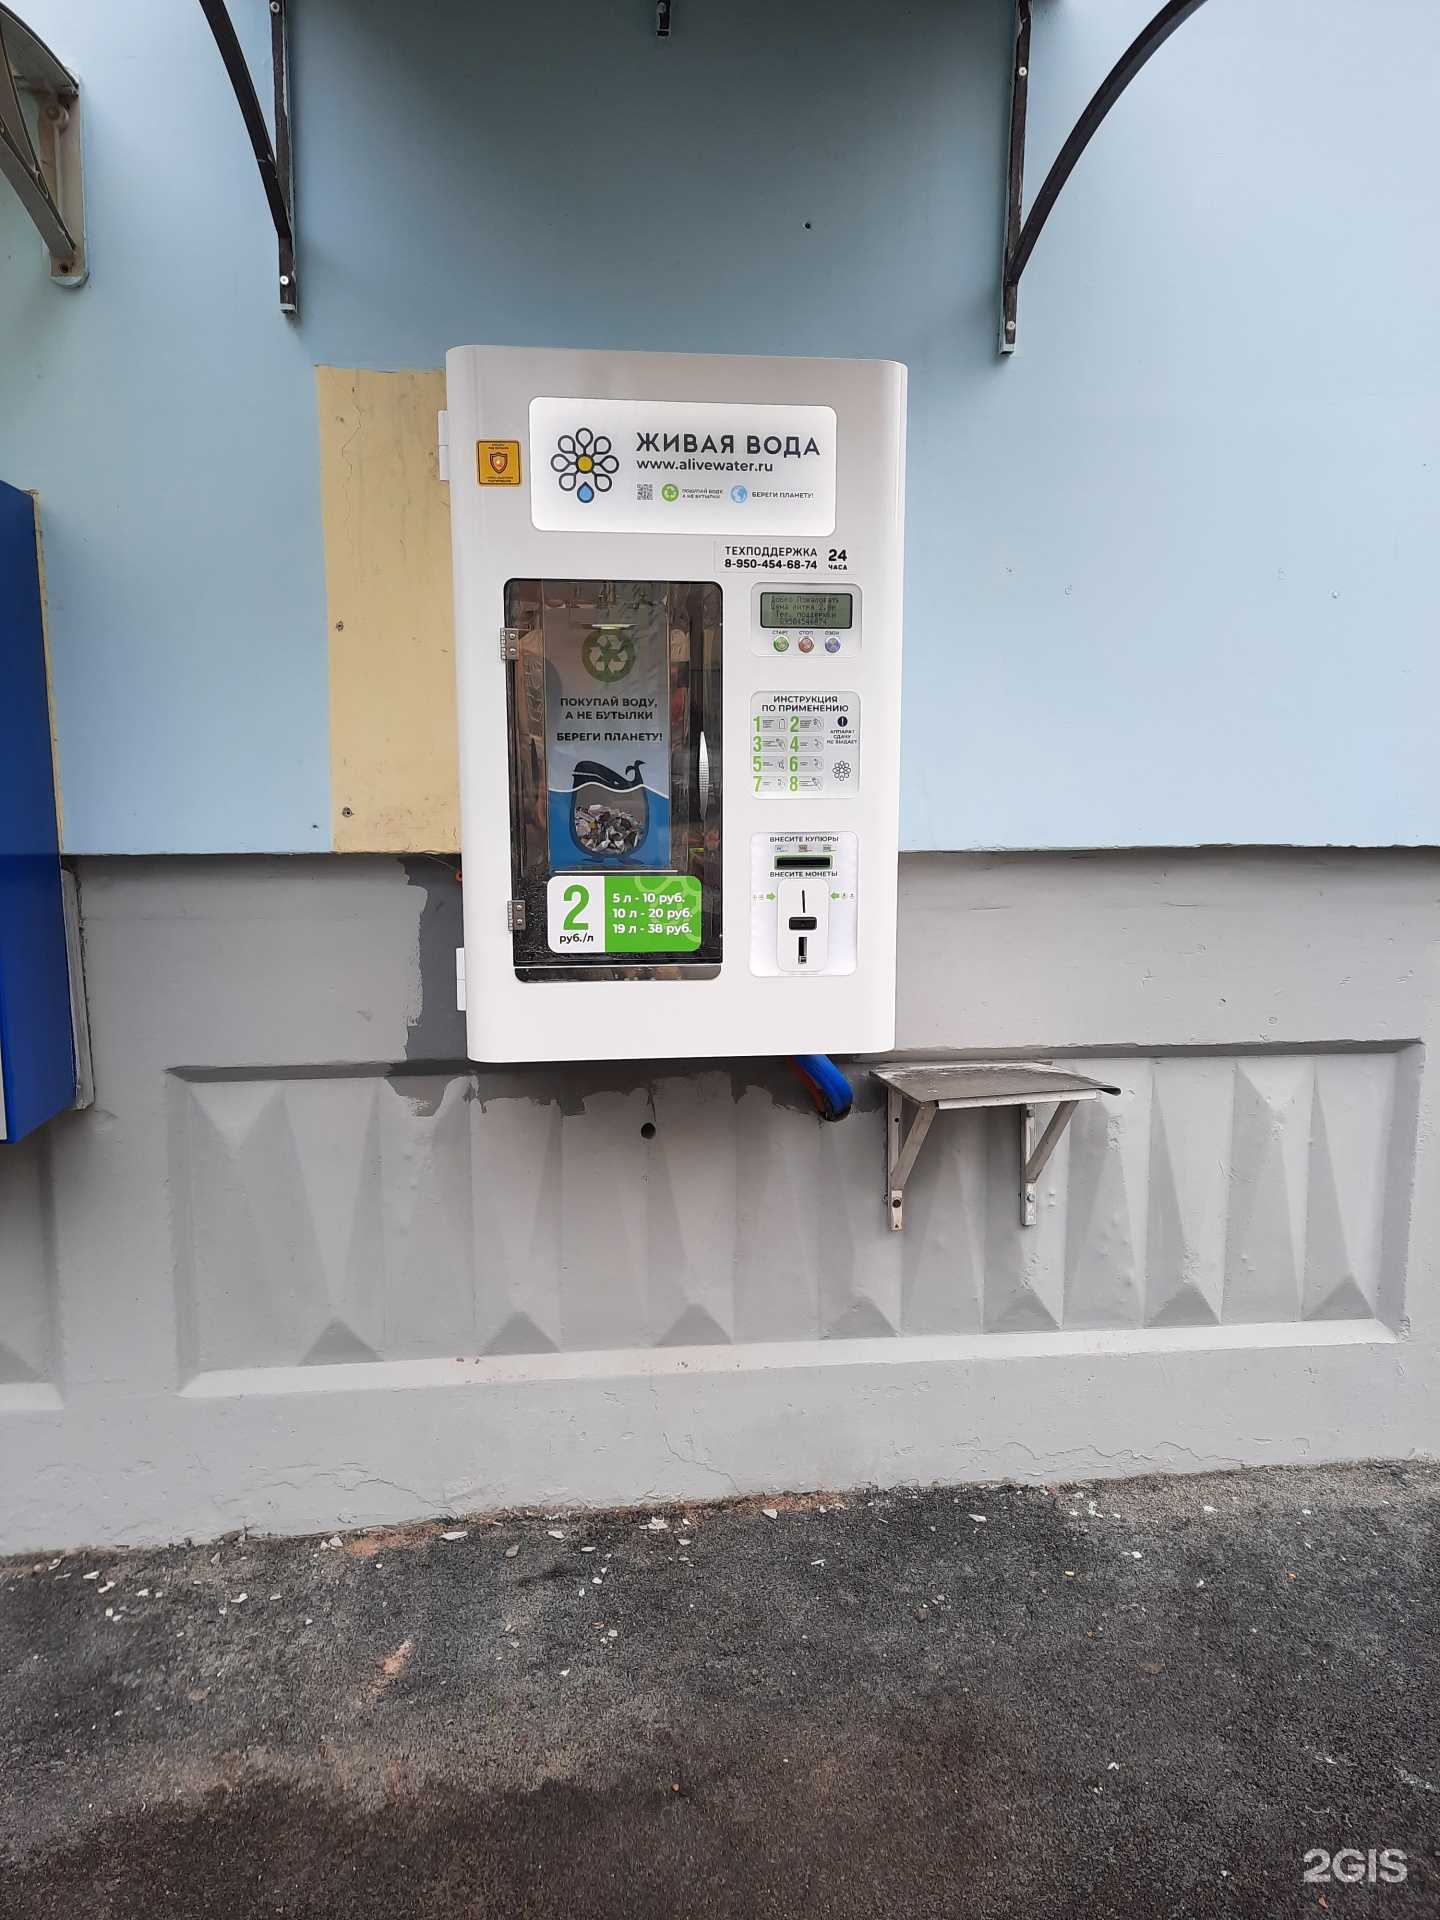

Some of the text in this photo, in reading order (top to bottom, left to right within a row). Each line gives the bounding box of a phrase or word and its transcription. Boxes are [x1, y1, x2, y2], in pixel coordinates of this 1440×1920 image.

[636, 432, 821, 458] ЖИВАЯ ВОДА
[636, 458, 773, 472] www.alivewater.ru
[725, 546, 818, 557] ТЕХПОДДЕРЖКА
[828, 549, 847, 561] 24
[724, 558, 818, 569] 8-950-454-68-74
[560, 696, 658, 708] ПОКУПАЙ ВОДУ,
[773, 695, 838, 704] ИНСТРУКЦИЯ
[761, 704, 849, 712] ПО ПРИМЕНЕНИЮ
[565, 711, 653, 720] А НЕ БУТЫЛКИ
[753, 716, 761, 733] 1
[790, 716, 799, 733] 2
[556, 732, 663, 742] БЕРЕГИ ПЛАНЕТУ!
[753, 736, 761, 752] 3
[790, 736, 799, 752] 4
[753, 756, 761, 772] 5
[790, 756, 798, 772] 6
[753, 776, 761, 792] 7
[790, 776, 798, 792] 8
[612, 893, 620, 903] 5
[623, 895, 632, 903] л
[642, 893, 656, 903] 10
[659, 892, 685, 905] руб.
[563, 884, 590, 930] 2
[612, 908, 626, 918] 10
[628, 910, 637, 918] л
[648, 908, 663, 918] 20
[667, 908, 693, 920] руб.
[612, 923, 625, 934] 19
[628, 926, 637, 934] л
[648, 923, 663, 933] 38
[666, 923, 692, 936] руб.
[559, 932, 594, 944] руб./л
